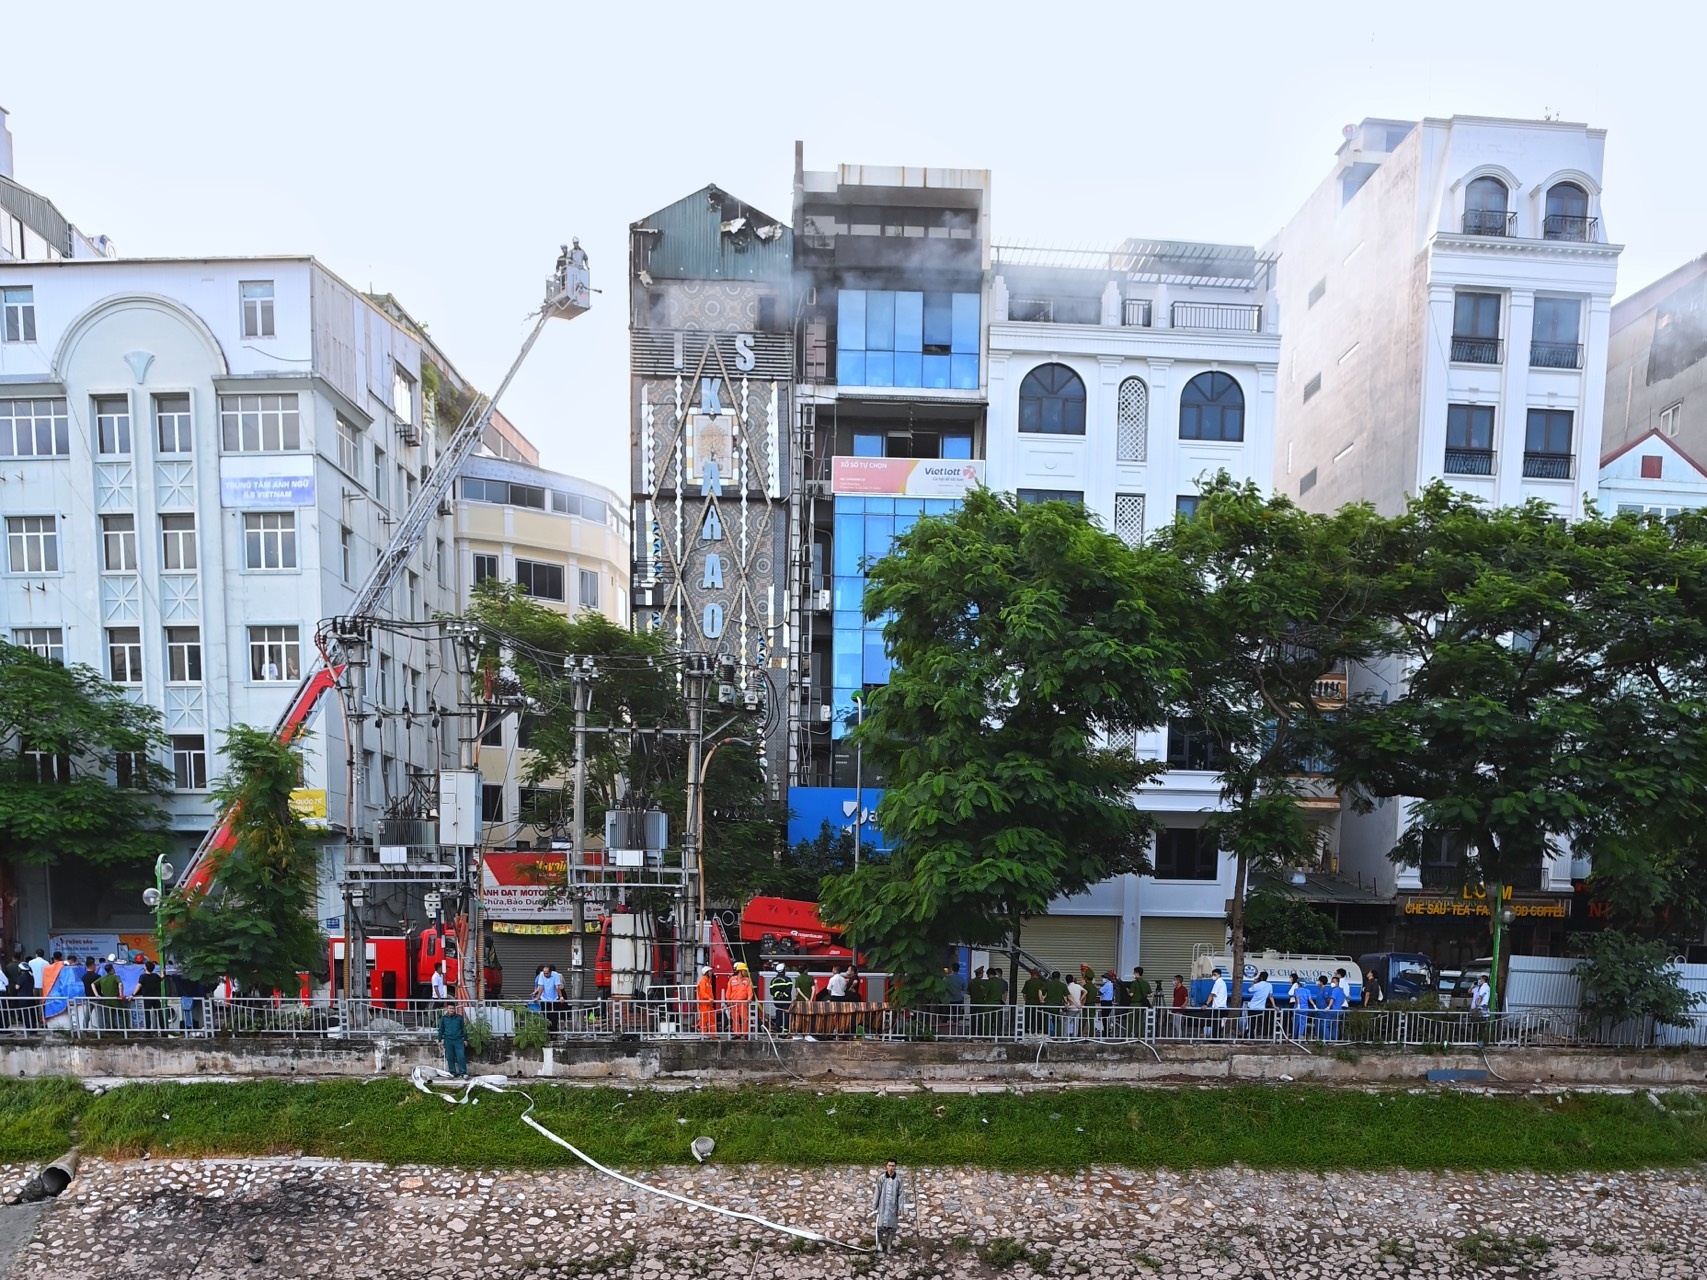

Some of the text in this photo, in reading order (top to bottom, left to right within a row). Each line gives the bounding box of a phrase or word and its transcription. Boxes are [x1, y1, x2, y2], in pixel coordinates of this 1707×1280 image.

[924, 467, 961, 476] Vietlott
[225, 481, 252, 489] TRUNG
[254, 480, 271, 489] TÂM
[272, 480, 290, 489] ANH
